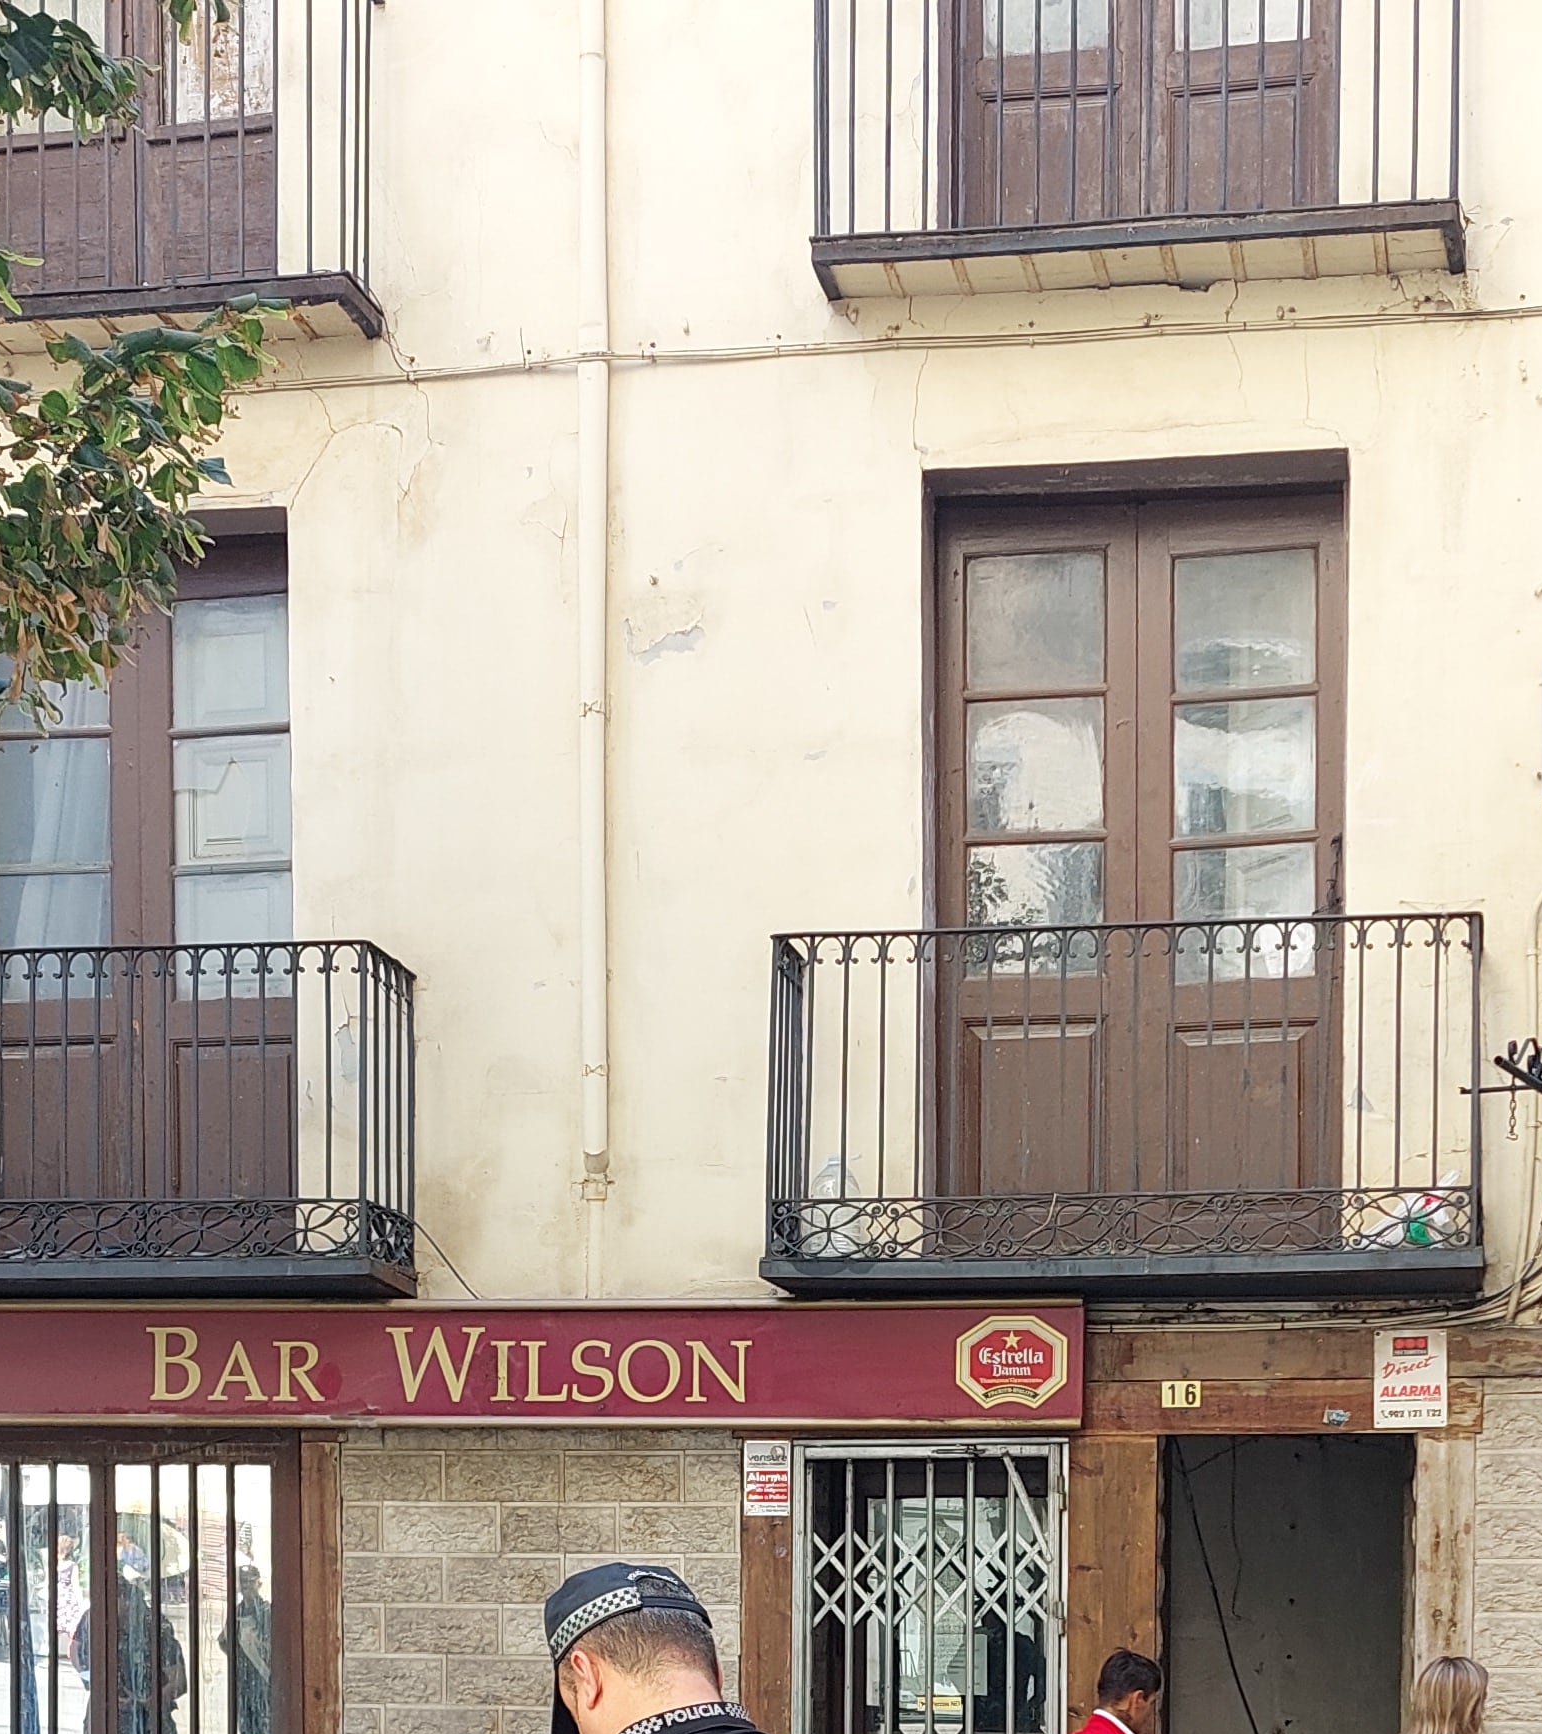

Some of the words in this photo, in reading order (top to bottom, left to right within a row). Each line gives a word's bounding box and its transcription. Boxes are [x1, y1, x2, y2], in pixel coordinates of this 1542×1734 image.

[979, 1346, 1044, 1365] Estrella
[146, 1326, 325, 1402] BAR
[385, 1326, 753, 1403] WILSON
[992, 1364, 1032, 1377] Damm
[1380, 1384, 1442, 1398] ALARMA
[1388, 1409, 1405, 1418] 902
[747, 1471, 788, 1483] Alarma
[664, 1703, 727, 1727] POLICIA
